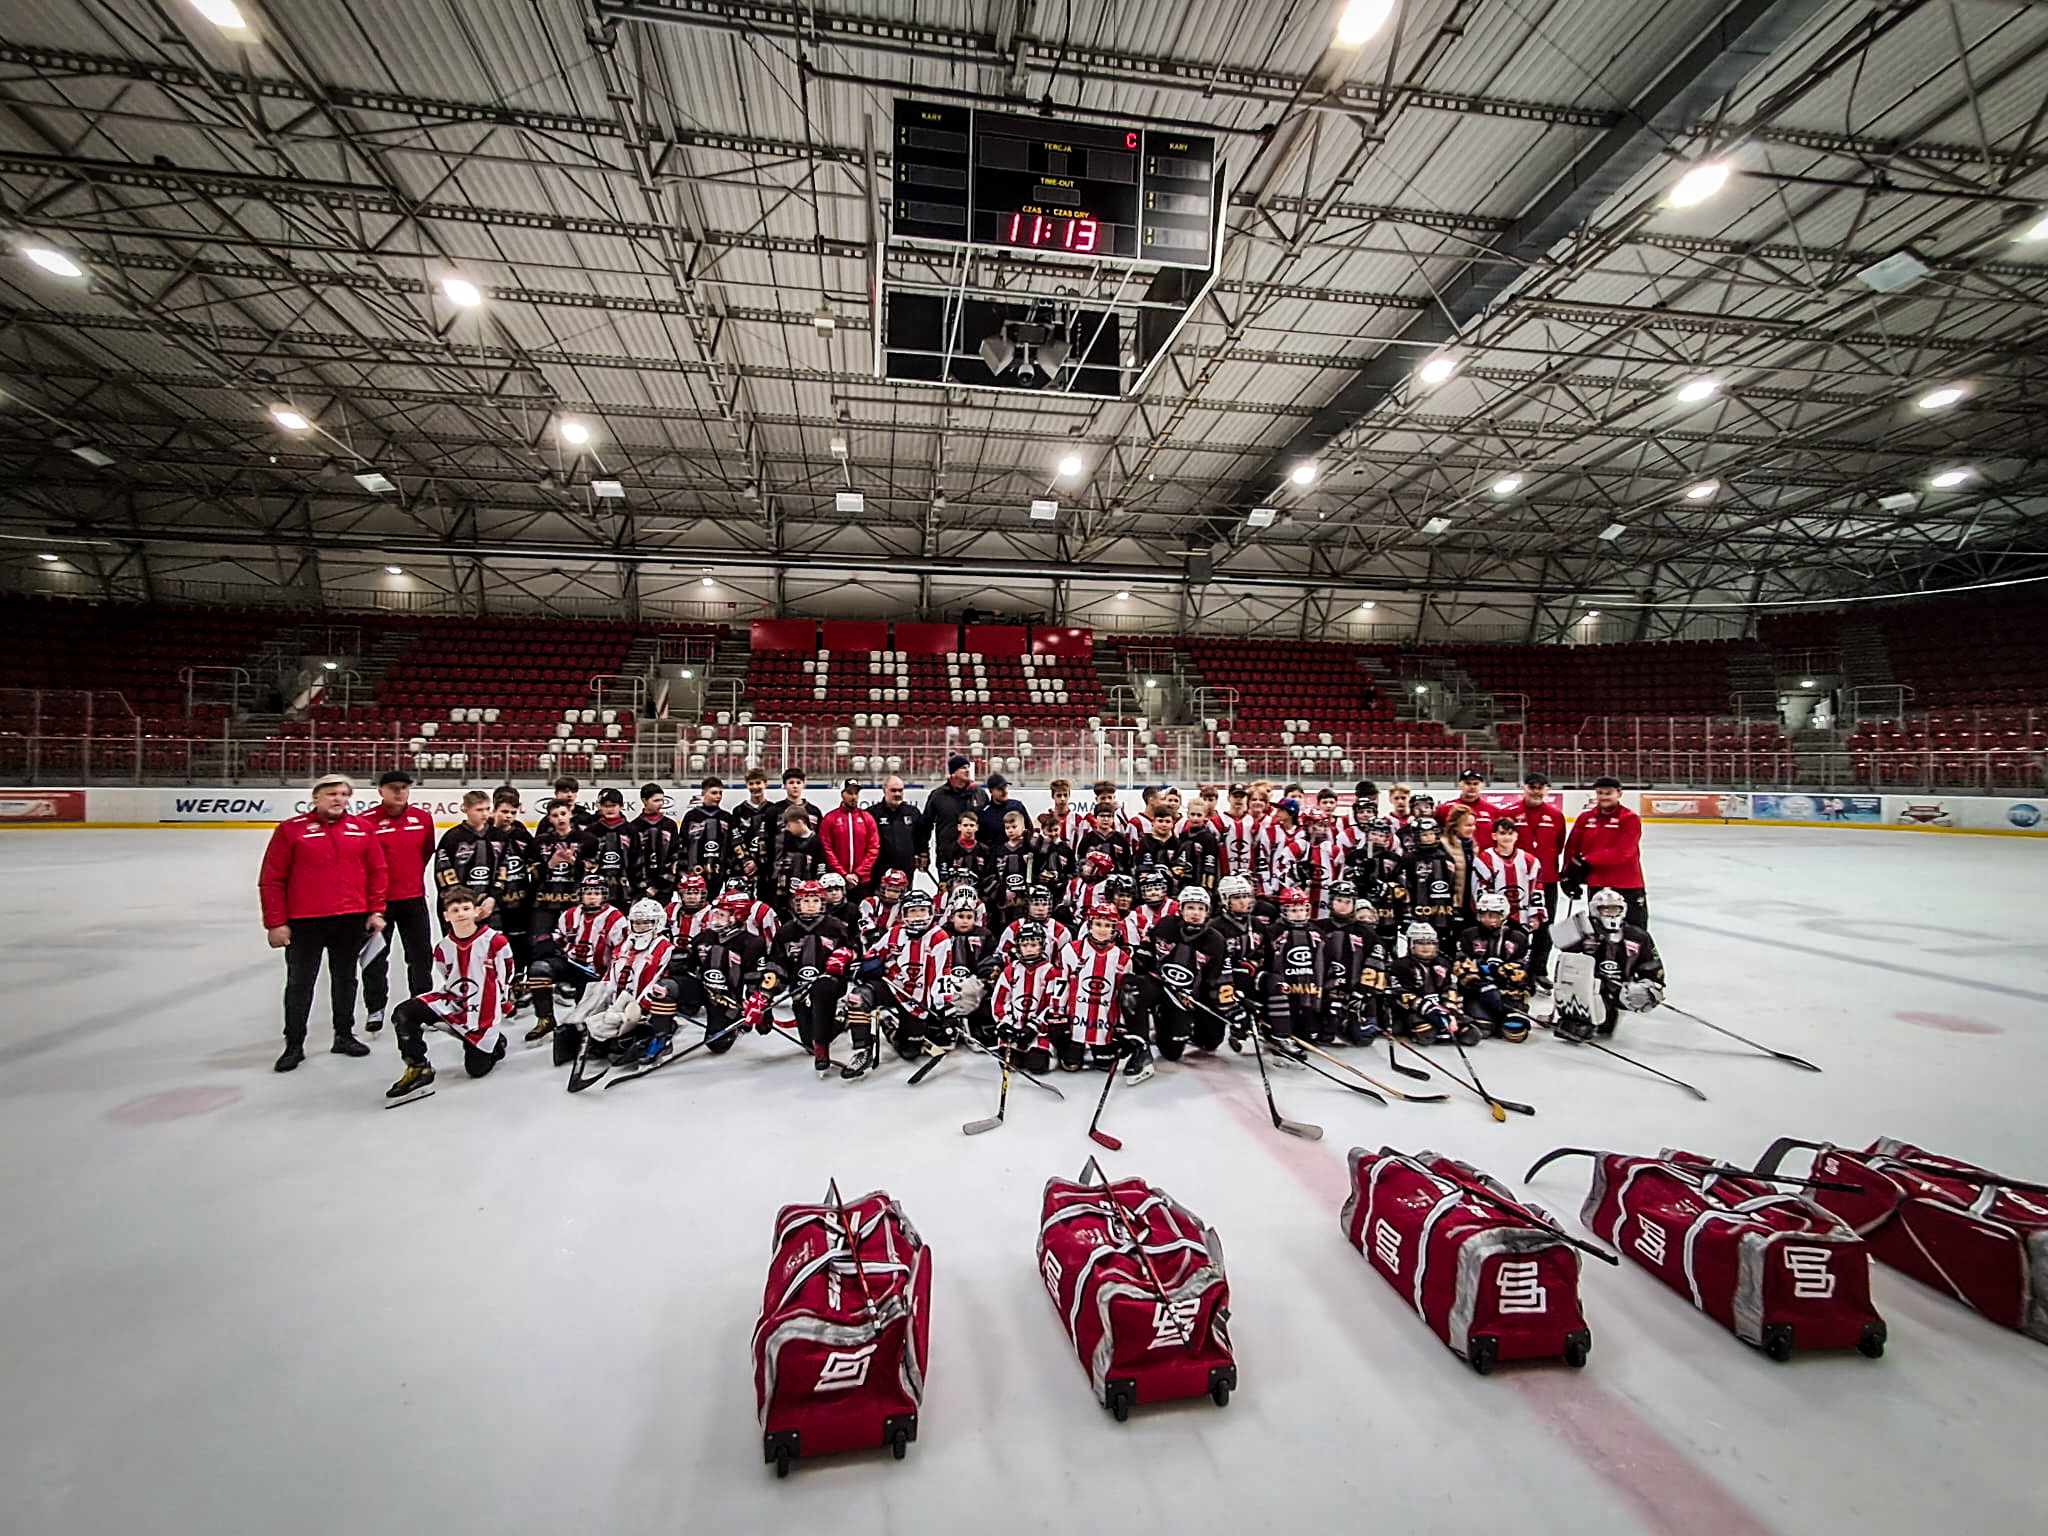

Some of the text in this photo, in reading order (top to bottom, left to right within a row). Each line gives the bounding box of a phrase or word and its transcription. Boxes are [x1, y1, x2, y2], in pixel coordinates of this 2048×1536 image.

[1044, 142, 1072, 153] TERCJA
[1126, 132, 1137, 148] C
[1041, 177, 1075, 188] TIME-OUT
[1010, 214, 1097, 250] 11:13
[176, 799, 265, 813] WERON
[1361, 967, 1386, 990] 21
